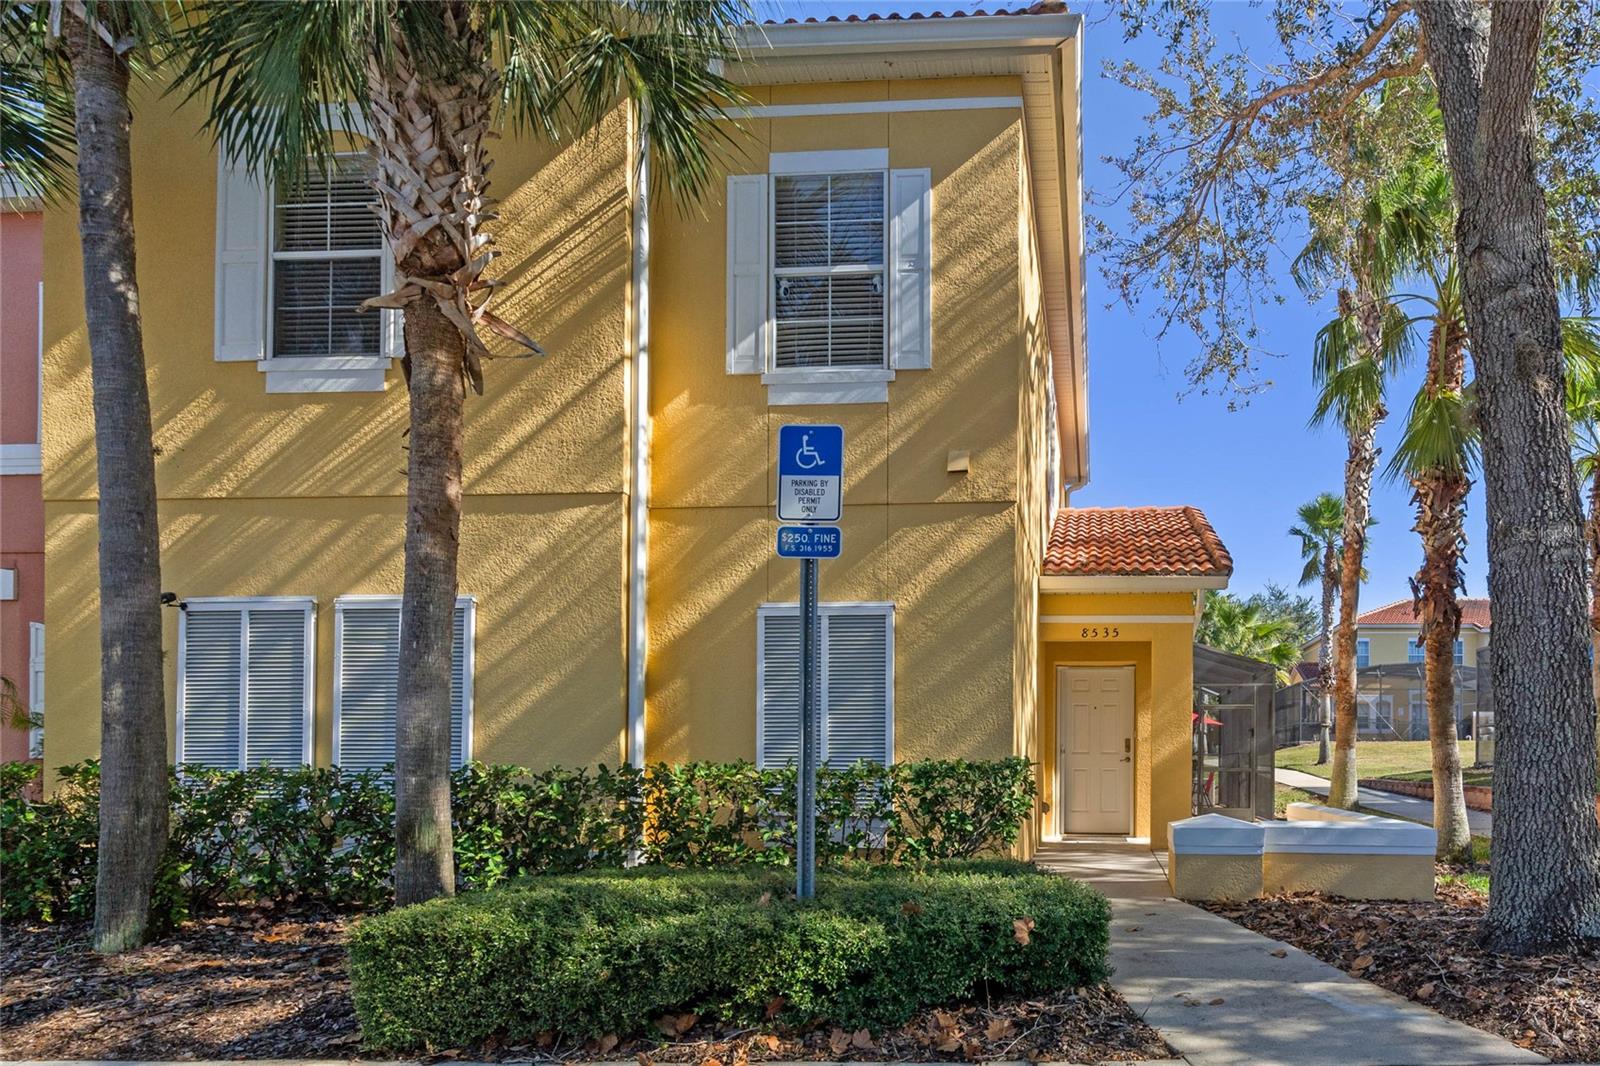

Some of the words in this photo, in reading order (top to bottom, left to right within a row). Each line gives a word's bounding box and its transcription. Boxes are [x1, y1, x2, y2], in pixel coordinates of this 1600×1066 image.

[794, 488, 826, 496] DISABLED
[801, 505, 818, 513] ONLY
[814, 533, 837, 544] FINE
[1081, 627, 1119, 638] 8535
